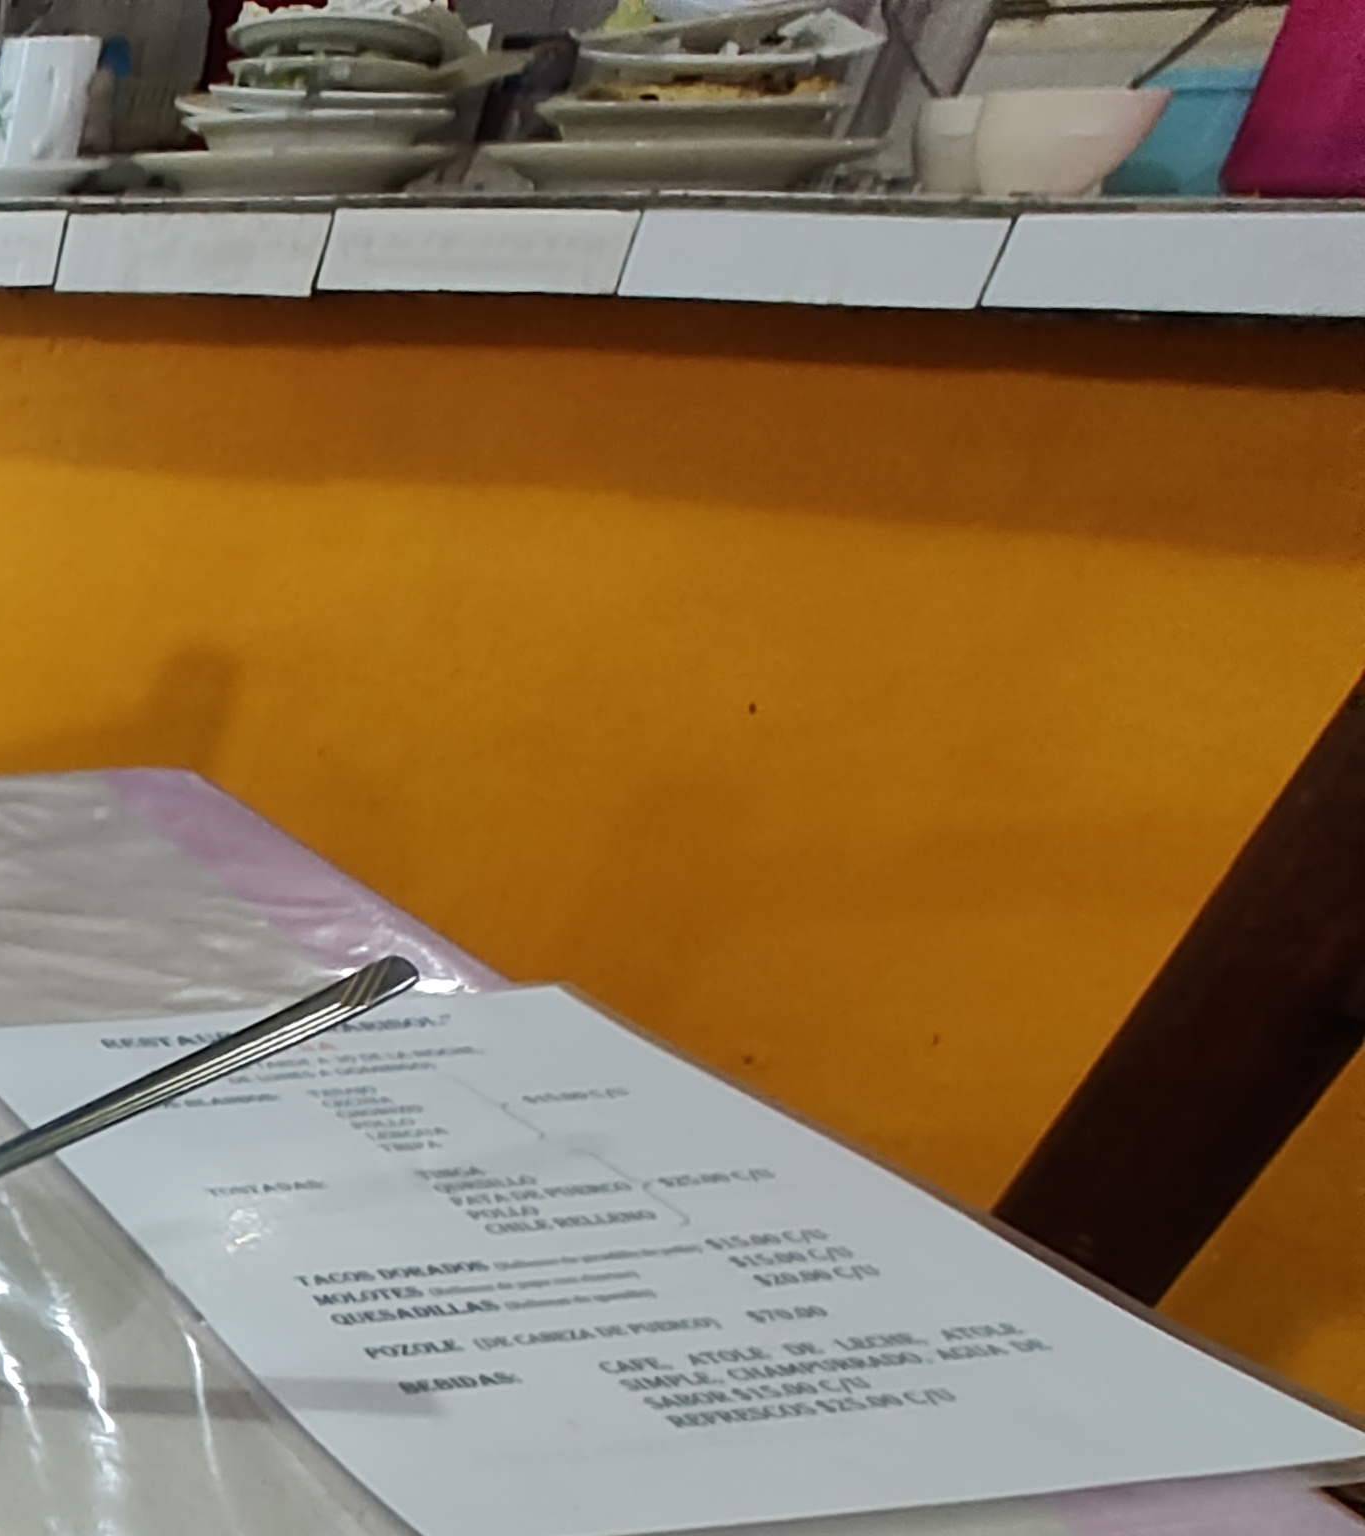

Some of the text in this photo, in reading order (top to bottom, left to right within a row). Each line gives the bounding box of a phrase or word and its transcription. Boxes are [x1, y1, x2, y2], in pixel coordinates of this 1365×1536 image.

[466, 1205, 539, 1220] POLLO
[484, 1209, 658, 1234] CHILE RELLENO
[295, 1269, 375, 1288] TACOS
[377, 1260, 490, 1280] DORADOS
[704, 1231, 782, 1251] $15.00
[782, 1228, 830, 1245] C/U
[312, 1285, 425, 1307] MOLOTES
[728, 1250, 807, 1269] $15.00
[807, 1244, 854, 1263] C/U
[330, 1299, 500, 1326] QUESADILLAS
[753, 1267, 832, 1288] $20.00
[832, 1262, 881, 1281] C/U
[364, 1304, 829, 1360] POZOLE (DE CABEZA DE PUERCO) $70.00
[687, 1345, 773, 1370] ATOLE
[782, 1339, 824, 1357] DE
[834, 1330, 929, 1353] LECHE,
[939, 1321, 1026, 1342] ATOLE
[398, 1371, 522, 1396] BEBIDAS:
[619, 1369, 725, 1394] SIMPLE,
[935, 1341, 1009, 1364] AGUA
[1010, 1336, 1053, 1354] DE
[643, 1374, 872, 1411] SABOR $15.00 C/U
[665, 1385, 958, 1429] REFRESCOS $25.00 C/U
